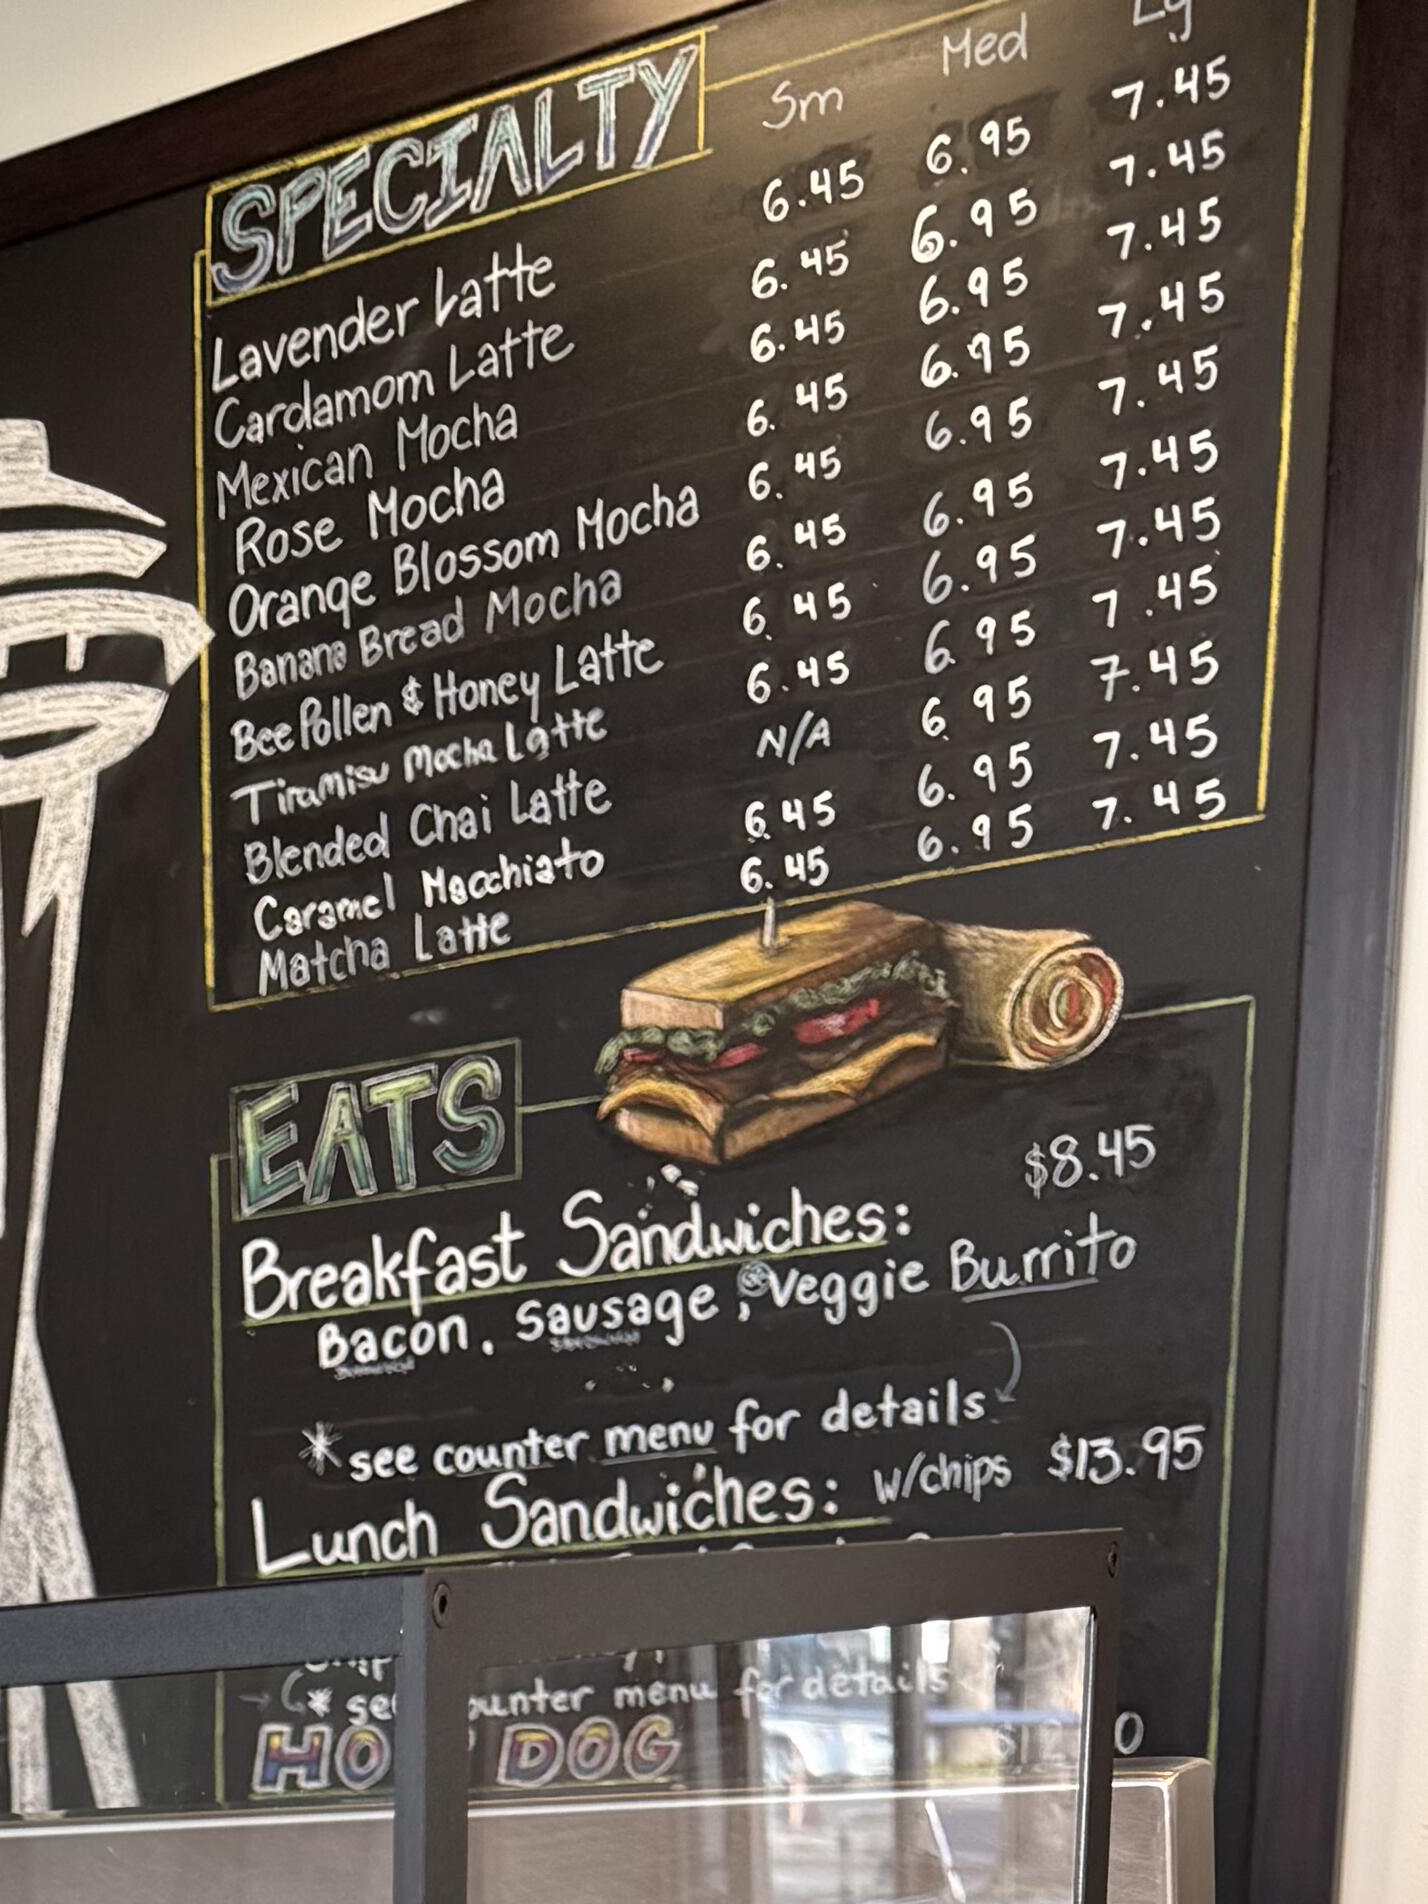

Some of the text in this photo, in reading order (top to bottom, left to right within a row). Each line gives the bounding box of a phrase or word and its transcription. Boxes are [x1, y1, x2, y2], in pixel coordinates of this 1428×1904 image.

[212, 45, 698, 293] SPECIALTY
[761, 13, 1027, 129] Sm Med
[212, 55, 1231, 393] Lavender Latte 6.45 6.95 7.45
[214, 130, 1225, 449] Cardamom Latte 6.45 6.95 7.45
[217, 197, 1222, 519] Mexican Mocha 6.45 6.95 7.45
[235, 271, 1224, 576] Rose Mocha 6.45 6.95 7.45
[229, 345, 1219, 637] Orange Blossom Mocha 6.45 6.95 7.45
[234, 428, 1219, 701] Banana Bread Mocha 6.45 6.95 7.45
[231, 496, 1221, 763] Bee Pollen Honey Latte 6.45 6.95 7.45
[231, 564, 1218, 825] Tiramisu Mocha Latte 6.45 6.95 7.45
[245, 641, 1219, 885] Blended Chai Latte N/A 6.95 7.45
[253, 713, 1219, 942] Caramel Macchiato 6.45 6.95 7.45
[259, 778, 1226, 997] Matcha Latte 6.45 6.95 7.45
[237, 1053, 506, 1214] EATS
[1024, 1124, 1157, 1199] $8.45
[242, 1188, 912, 1322] Breakfast Sandwiches:
[768, 1212, 1138, 1326] Veggie Burrito
[253, 1424, 1204, 1575] Lunch Sandwiches: $13.95
[433, 1431, 588, 1477] counter
[603, 1416, 715, 1458] menu
[727, 1399, 801, 1454] for
[822, 1379, 988, 1431] details
[496, 1713, 683, 1790] DOG
[614, 1666, 949, 1723] menu for details
